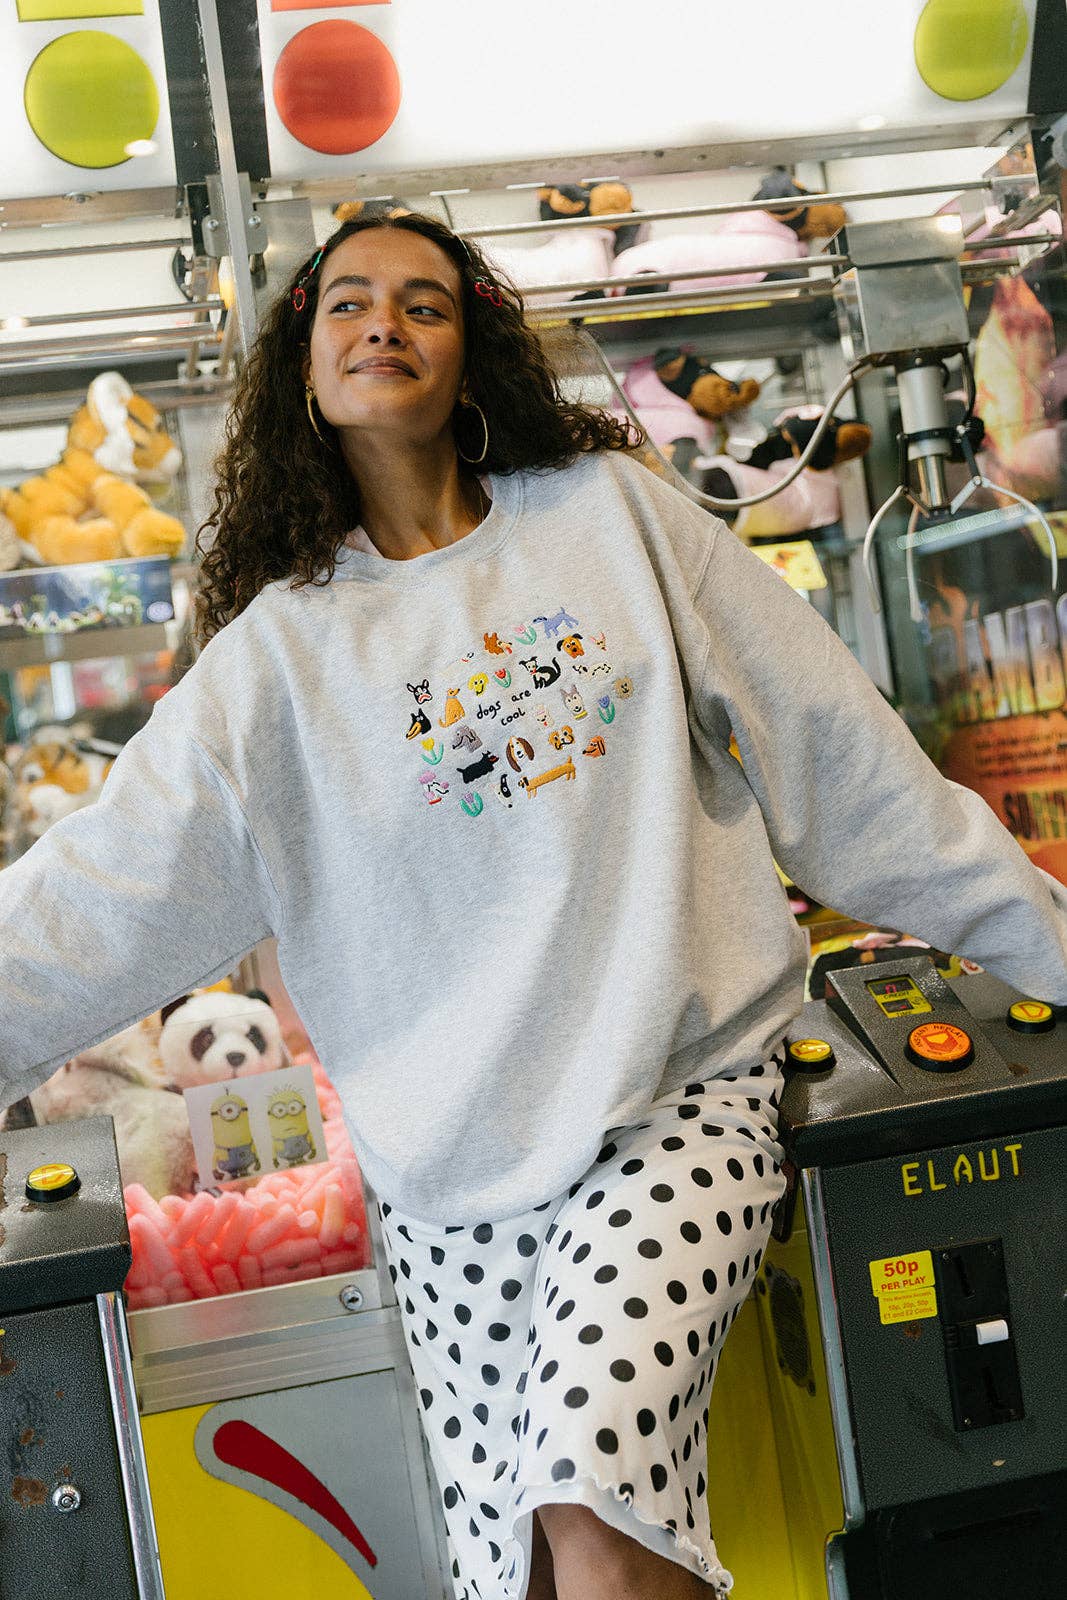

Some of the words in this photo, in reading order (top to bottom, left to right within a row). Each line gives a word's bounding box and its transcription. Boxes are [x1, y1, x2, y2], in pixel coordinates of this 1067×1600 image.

[476, 700, 501, 719] dogs
[511, 690, 531, 702] are
[501, 707, 525, 726] cool
[901, 1143, 1022, 1196] ELAUT
[884, 1260, 918, 1277] 50p
[881, 1282, 900, 1293] PER
[903, 1275, 926, 1287] PLAY
